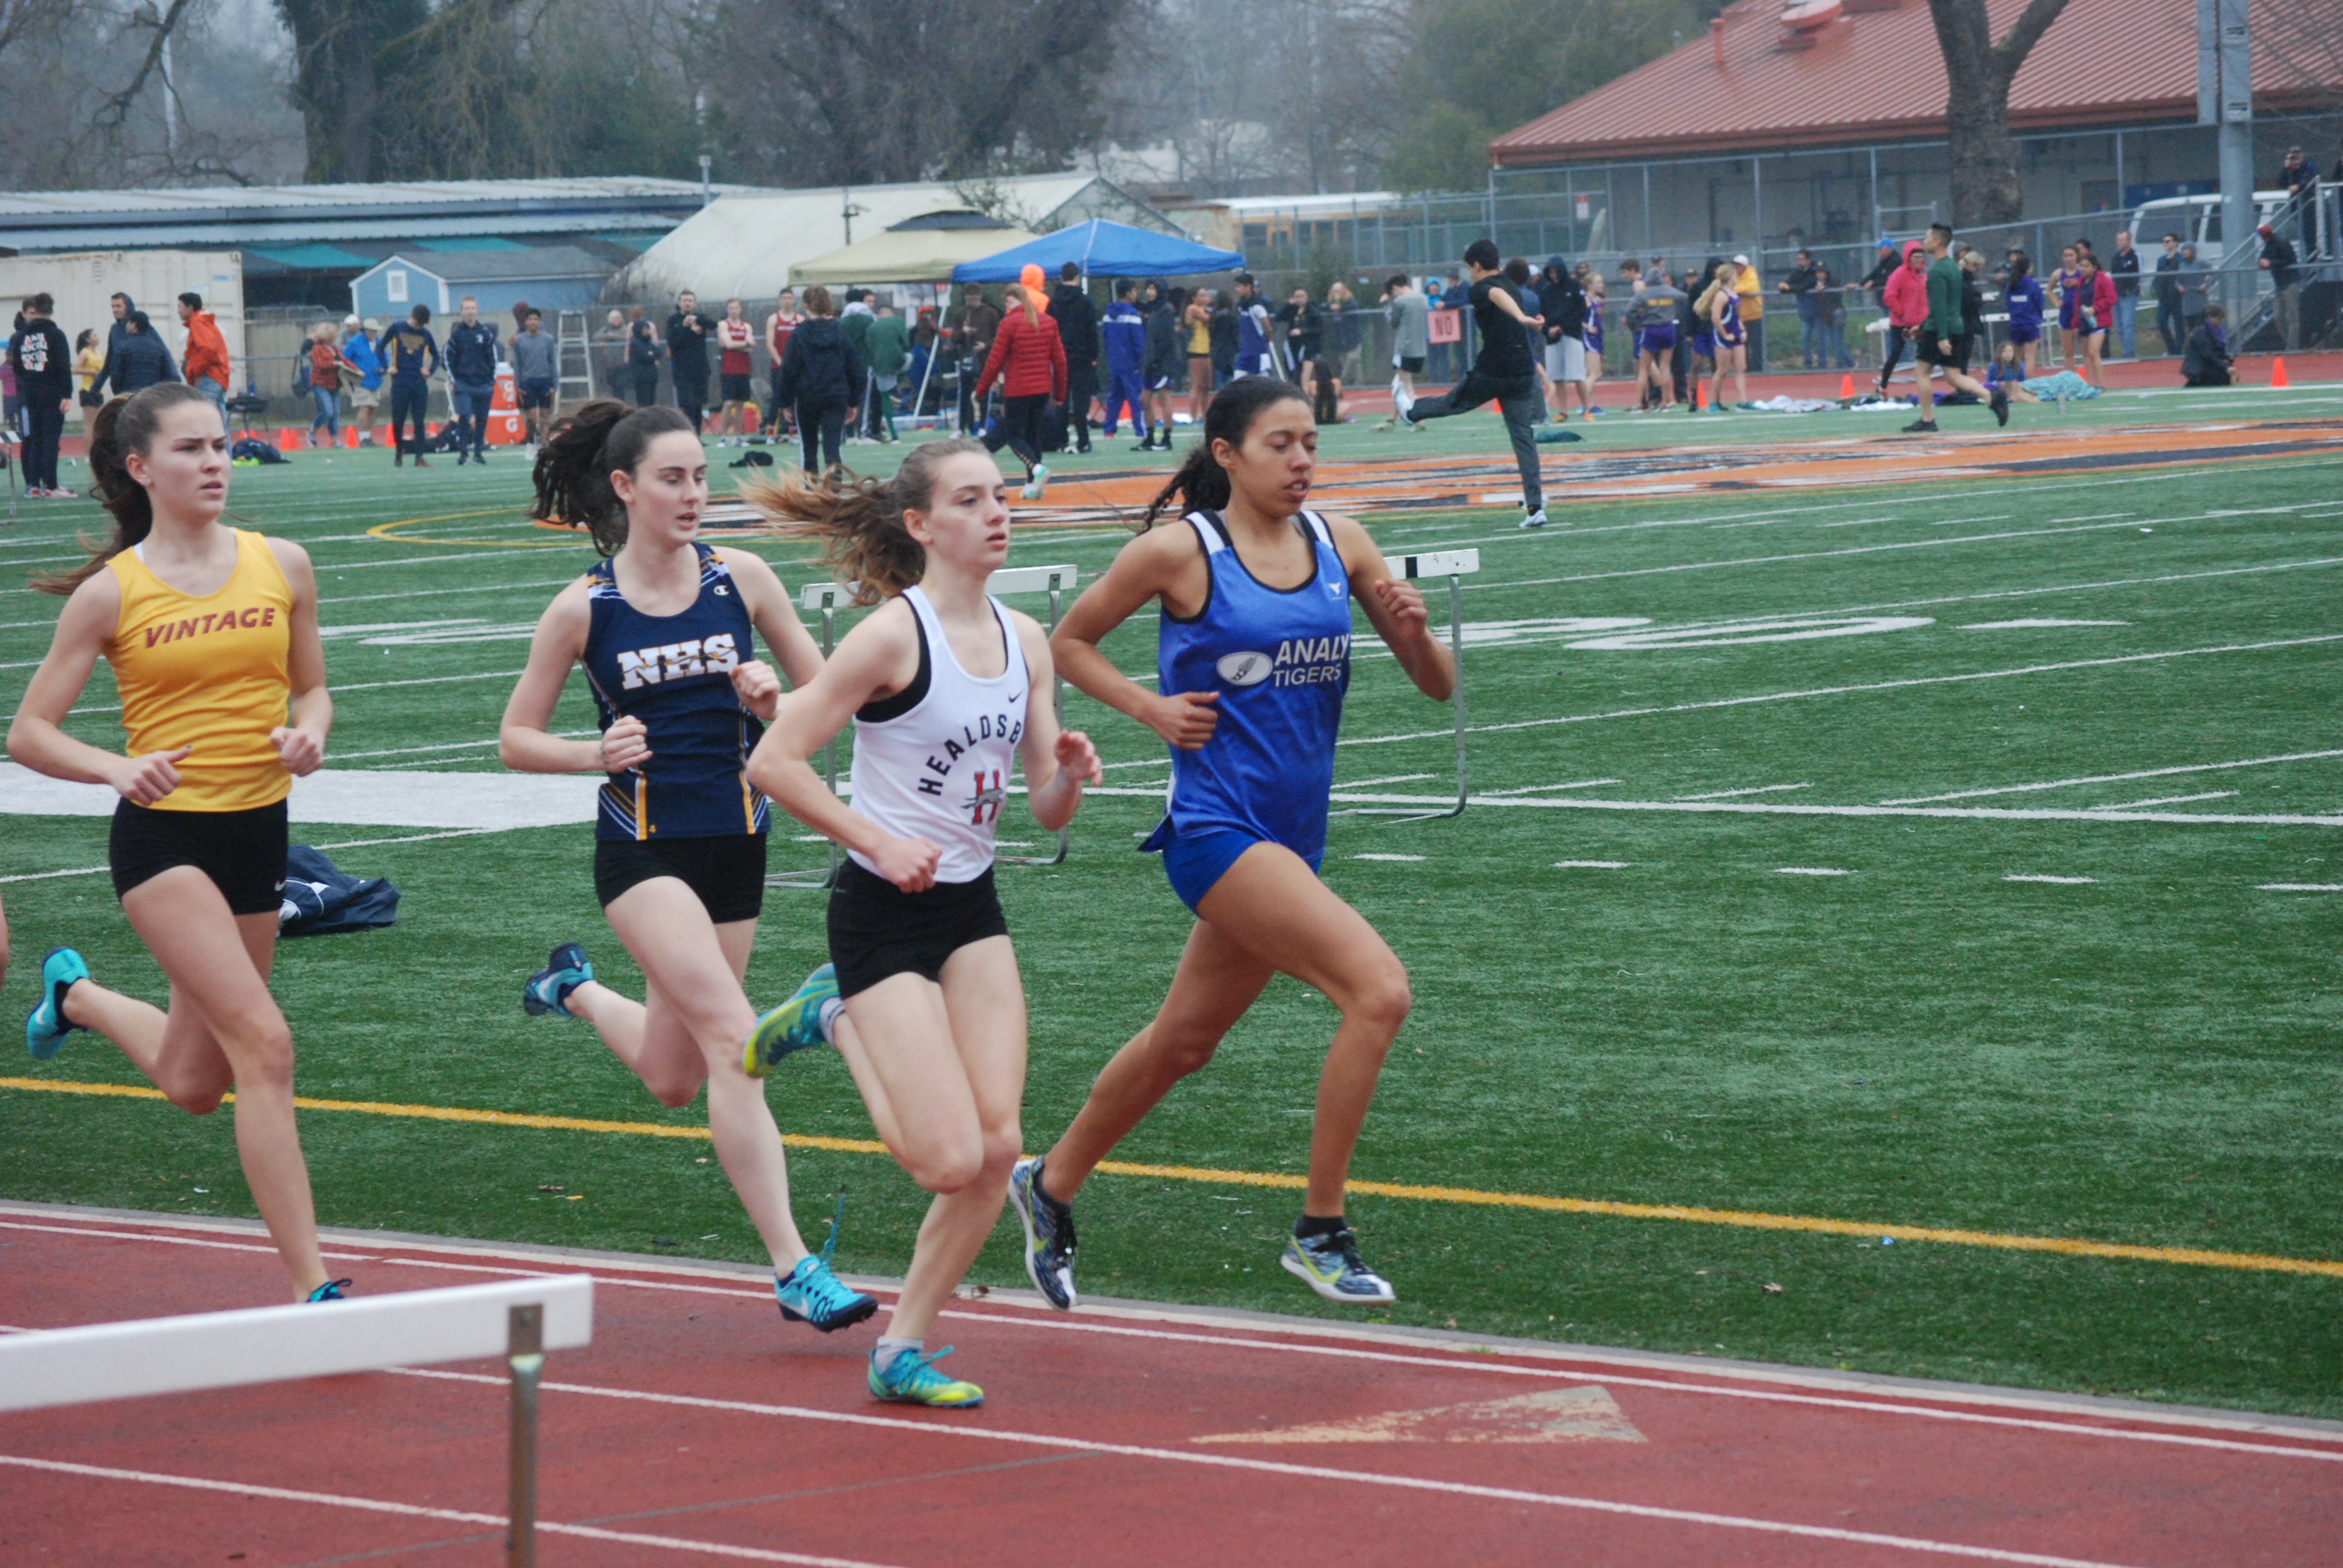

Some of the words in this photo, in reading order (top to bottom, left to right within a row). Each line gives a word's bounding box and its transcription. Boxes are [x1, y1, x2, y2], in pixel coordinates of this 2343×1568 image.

[1435, 316, 1453, 336] NO
[505, 417, 518, 433] G
[145, 607, 275, 649] VINTAGE
[617, 633, 739, 690] NHS
[1274, 633, 1350, 667] ANALY
[1273, 663, 1342, 687] TIGERS
